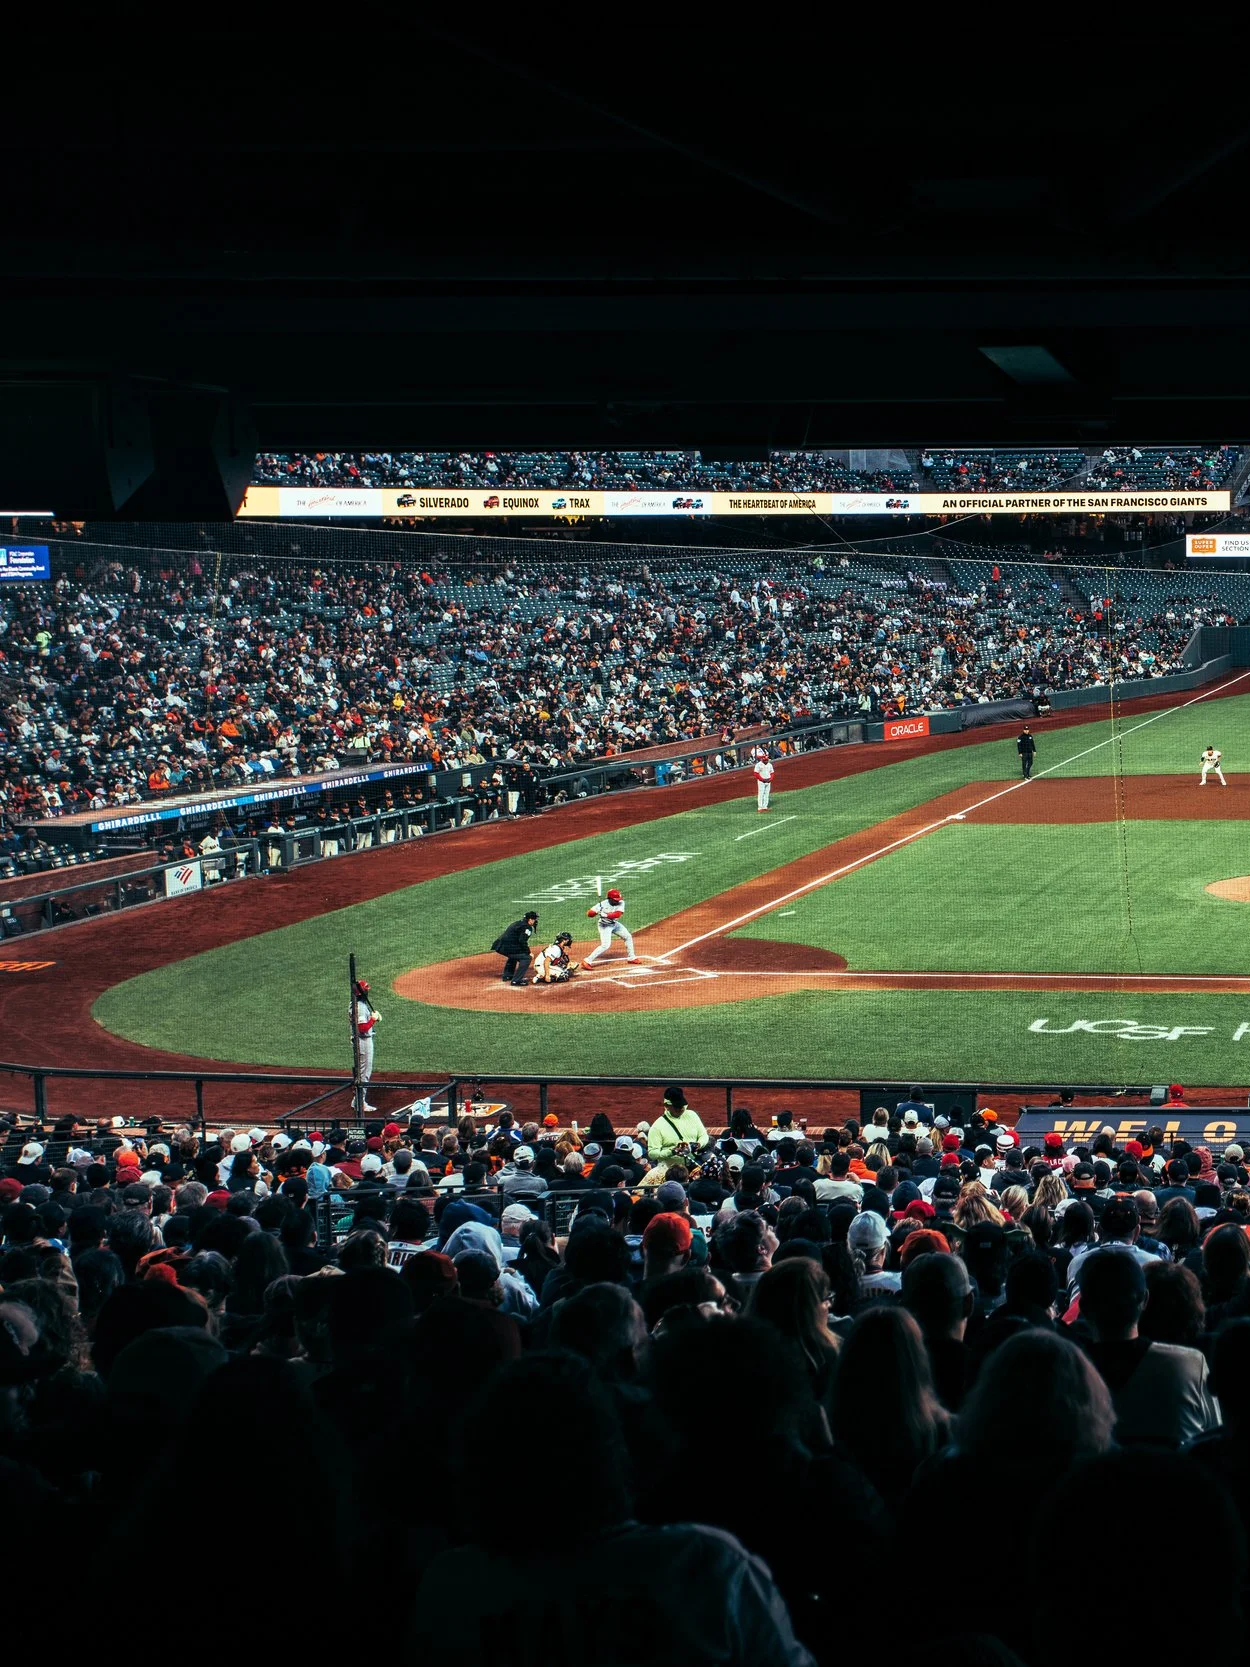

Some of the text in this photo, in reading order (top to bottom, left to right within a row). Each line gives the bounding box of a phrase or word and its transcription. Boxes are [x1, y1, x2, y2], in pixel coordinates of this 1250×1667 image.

[419, 497, 469, 508] SILVERADO
[503, 498, 539, 509] EQUINOX
[570, 498, 590, 508] TRAX
[729, 499, 816, 509] THE HEARTBEAT OF AMERICA
[943, 497, 1208, 508] AN OFFICIAL PARTNER OF THE SAN FRANCISCO GIANTS
[890, 722, 924, 737] ORACLE
[1028, 1018, 1215, 1041] UCSF
